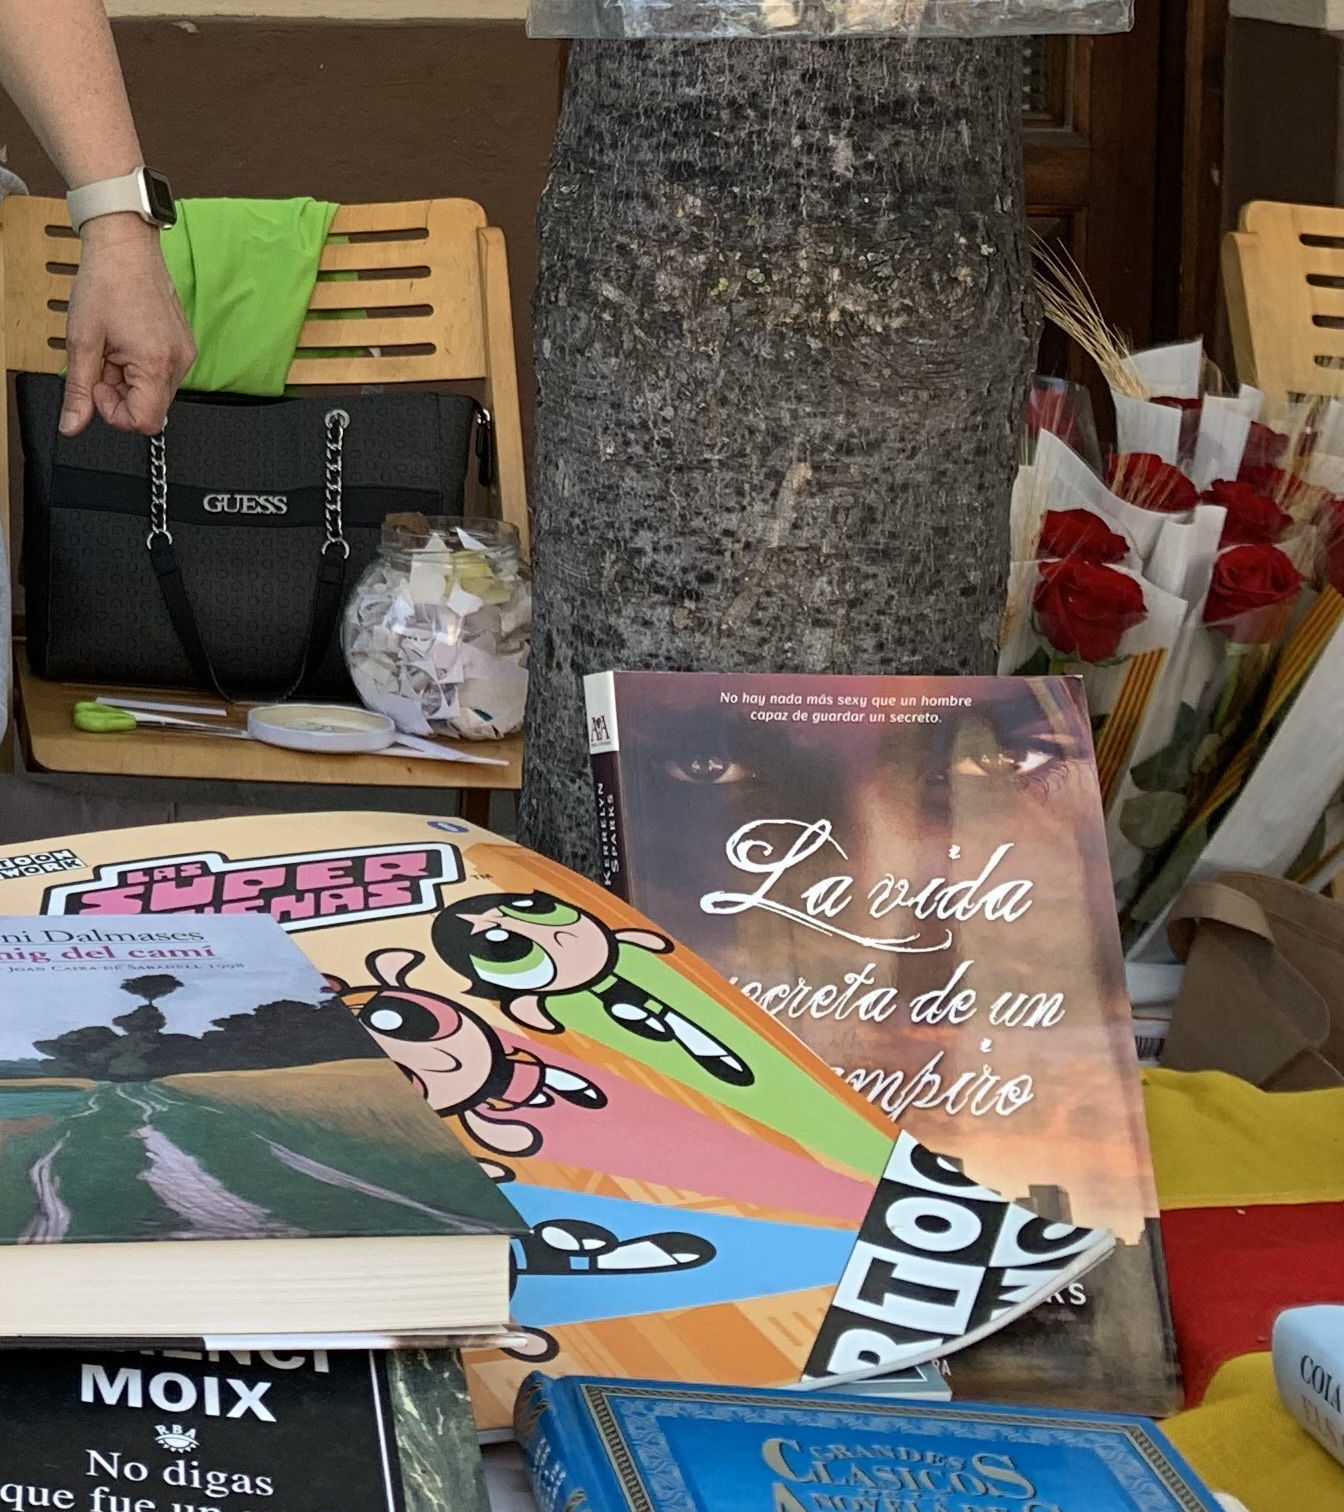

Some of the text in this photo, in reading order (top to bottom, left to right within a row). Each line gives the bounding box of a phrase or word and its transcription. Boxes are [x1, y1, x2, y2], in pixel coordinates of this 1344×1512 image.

[203, 493, 288, 515] GUESS
[719, 691, 973, 709] No hay nada más sexy que un hombre
[749, 709, 943, 725] capaz de guardar un secreto.
[597, 782, 614, 887] KERRELYN
[607, 792, 621, 874] SPARKS
[79, 850, 431, 914] SUPER
[126, 862, 204, 886] LAS
[700, 819, 1034, 950] La vida
[39, 929, 206, 945] Dalmases
[61, 945, 116, 961] del
[127, 945, 217, 960] camí
[729, 959, 1066, 1029] ecreta de un
[80, 1363, 278, 1424] MOIX
[154, 1423, 196, 1439] RBA
[810, 1444, 967, 1471] GRANDES
[84, 1448, 276, 1498] No digas
[0, 1482, 156, 1512] que fue
